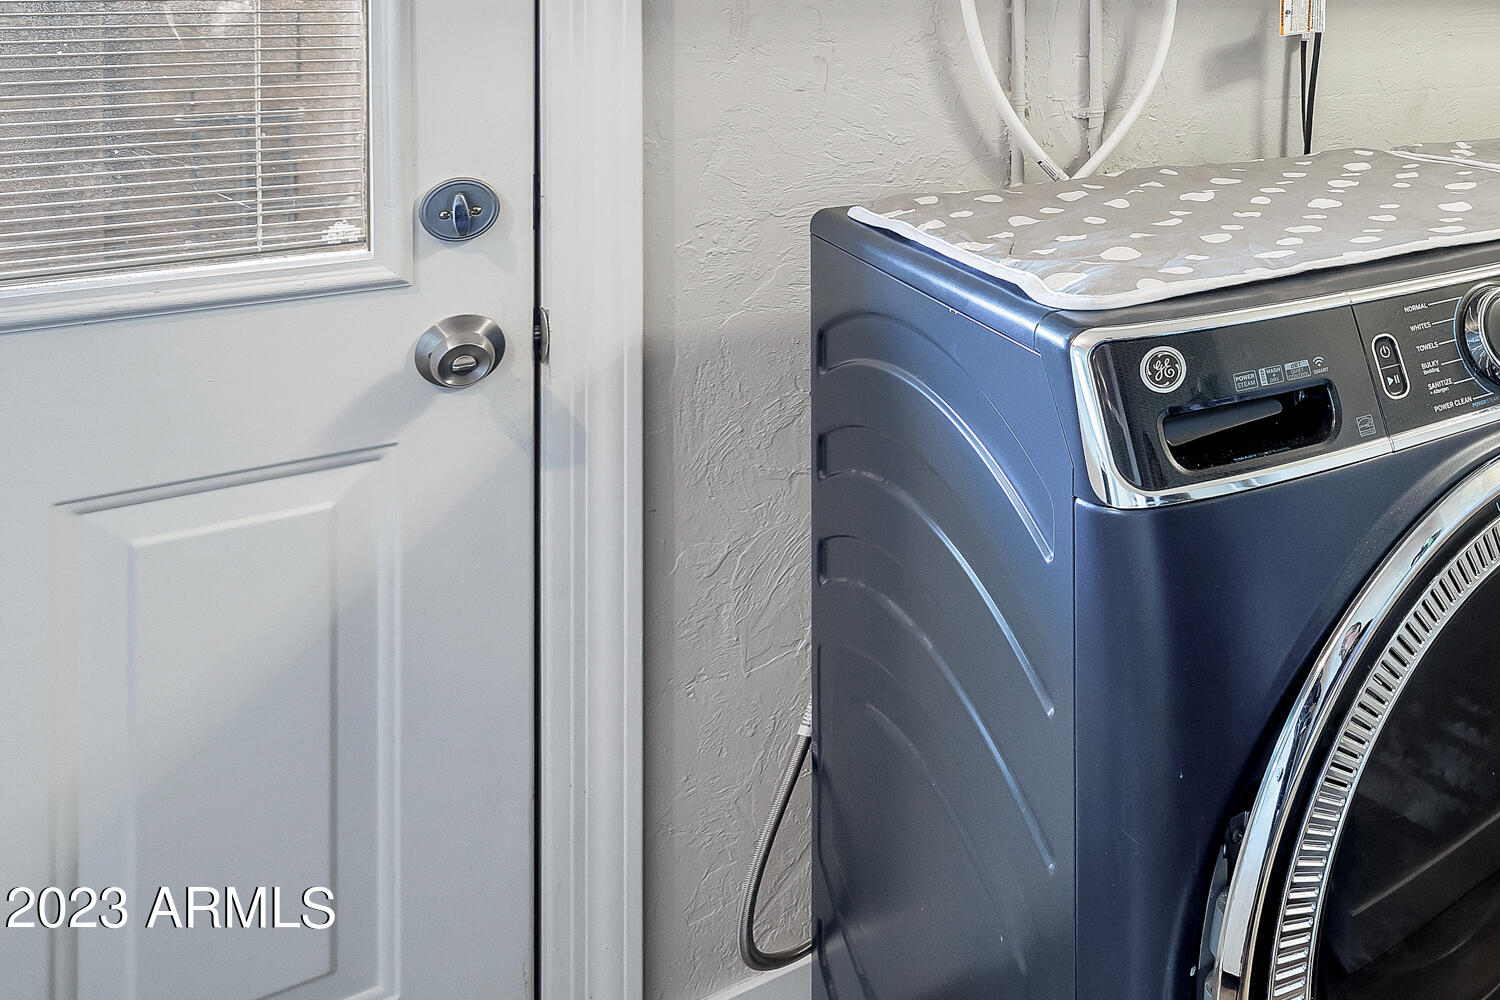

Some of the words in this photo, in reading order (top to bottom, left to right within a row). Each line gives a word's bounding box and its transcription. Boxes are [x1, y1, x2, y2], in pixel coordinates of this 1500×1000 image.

[1403, 302, 1429, 313] NORMAL
[1409, 321, 1432, 332] WHITES
[1415, 341, 1439, 353] TOWELS
[1420, 359, 1440, 370] BULKY
[1313, 367, 1329, 375] SMART
[1235, 374, 1255, 382] POWER
[1237, 380, 1256, 389] STEAM
[1427, 377, 1454, 391] SANITIZE
[1433, 401, 1455, 413] POWER
[1454, 396, 1473, 407] CLEAN
